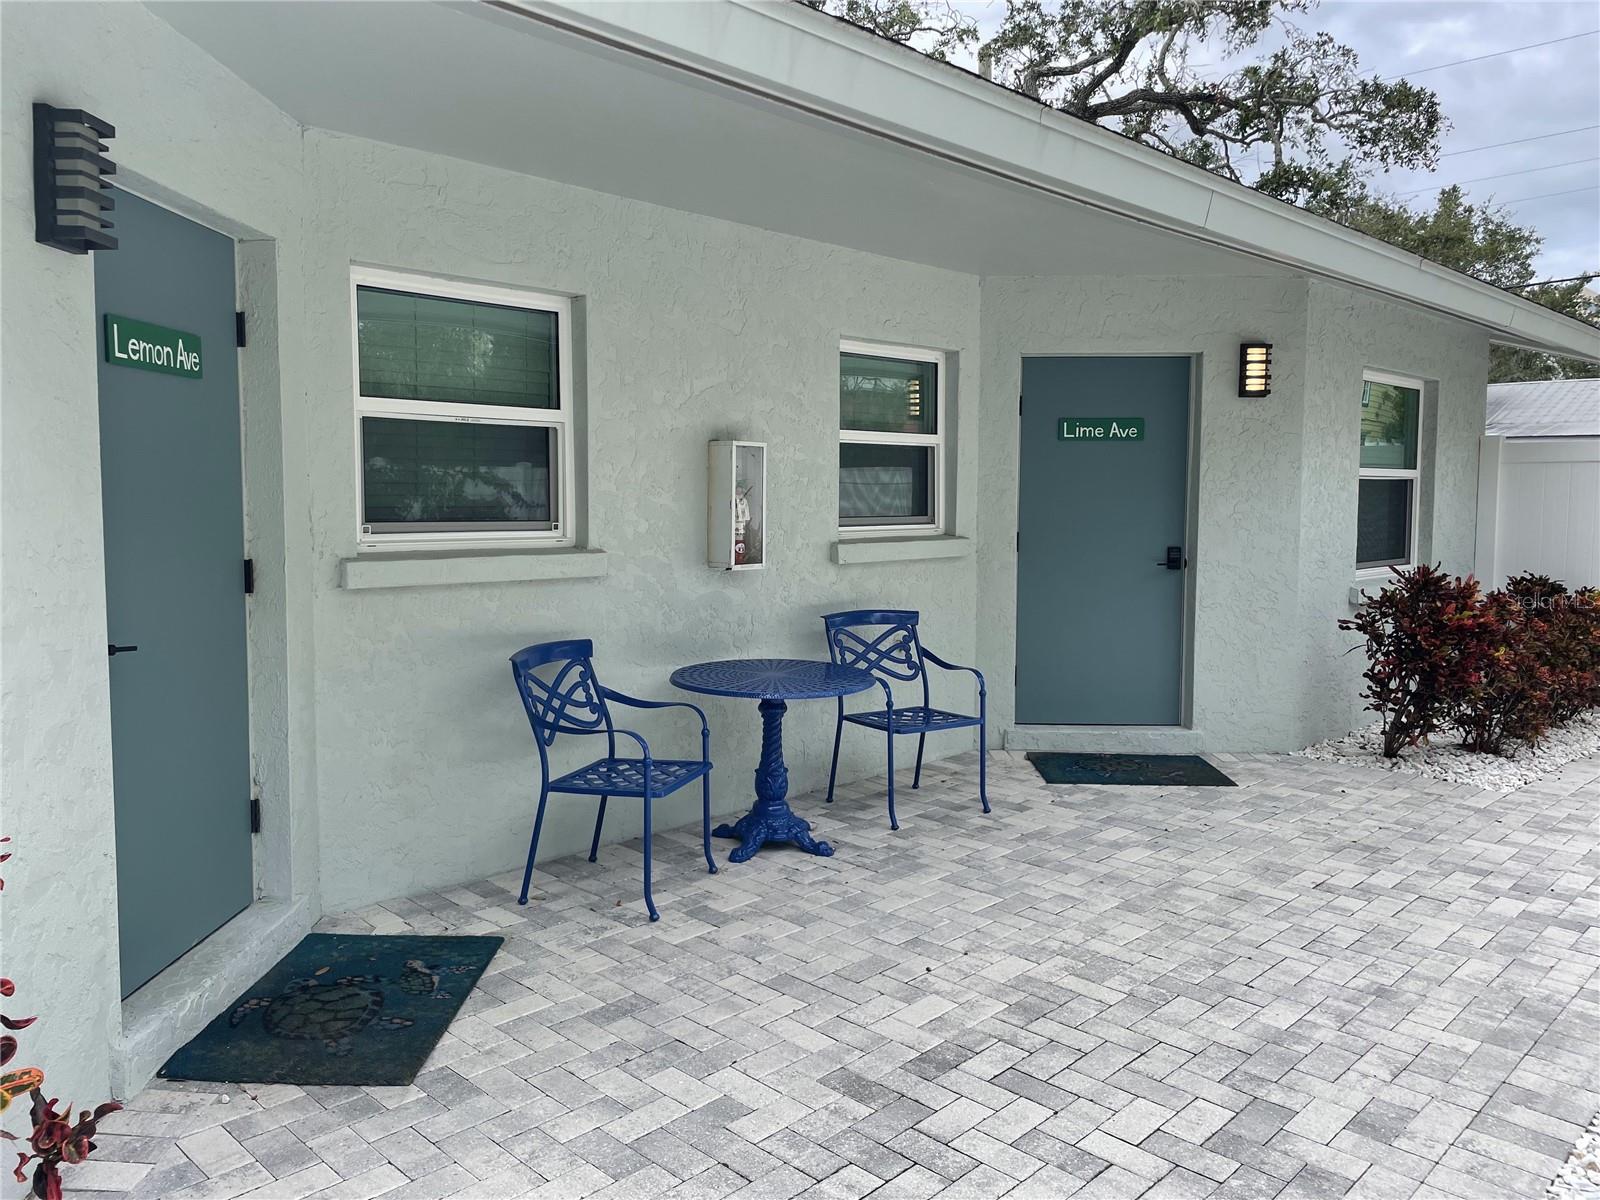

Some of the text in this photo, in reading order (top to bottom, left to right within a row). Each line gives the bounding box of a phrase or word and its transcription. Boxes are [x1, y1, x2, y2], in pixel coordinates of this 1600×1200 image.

[113, 323, 200, 371] Lemon Ave
[1063, 421, 1138, 438] Lime Ave
